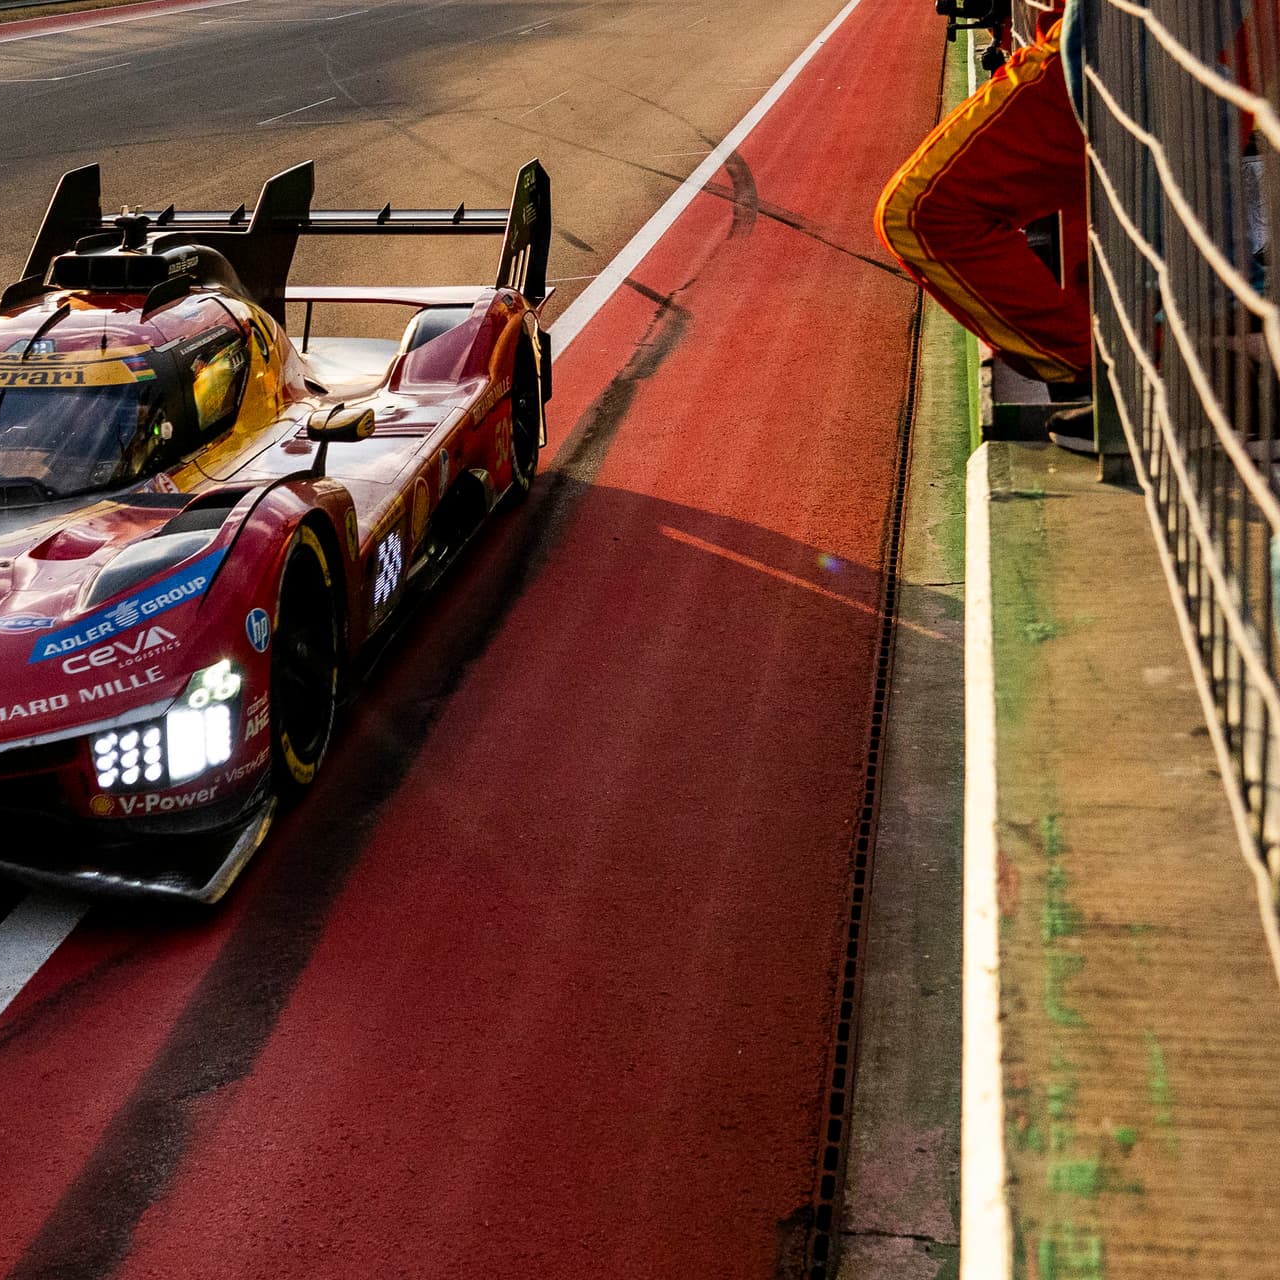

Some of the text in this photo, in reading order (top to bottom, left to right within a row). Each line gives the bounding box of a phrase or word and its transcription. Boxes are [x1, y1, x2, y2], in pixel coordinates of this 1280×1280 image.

[43, 576, 207, 656] ADLER GROUP
[250, 611, 268, 648] hp
[118, 641, 182, 669] LOGISTICS
[78, 665, 166, 704] MILLE
[118, 784, 218, 815] V-Power
